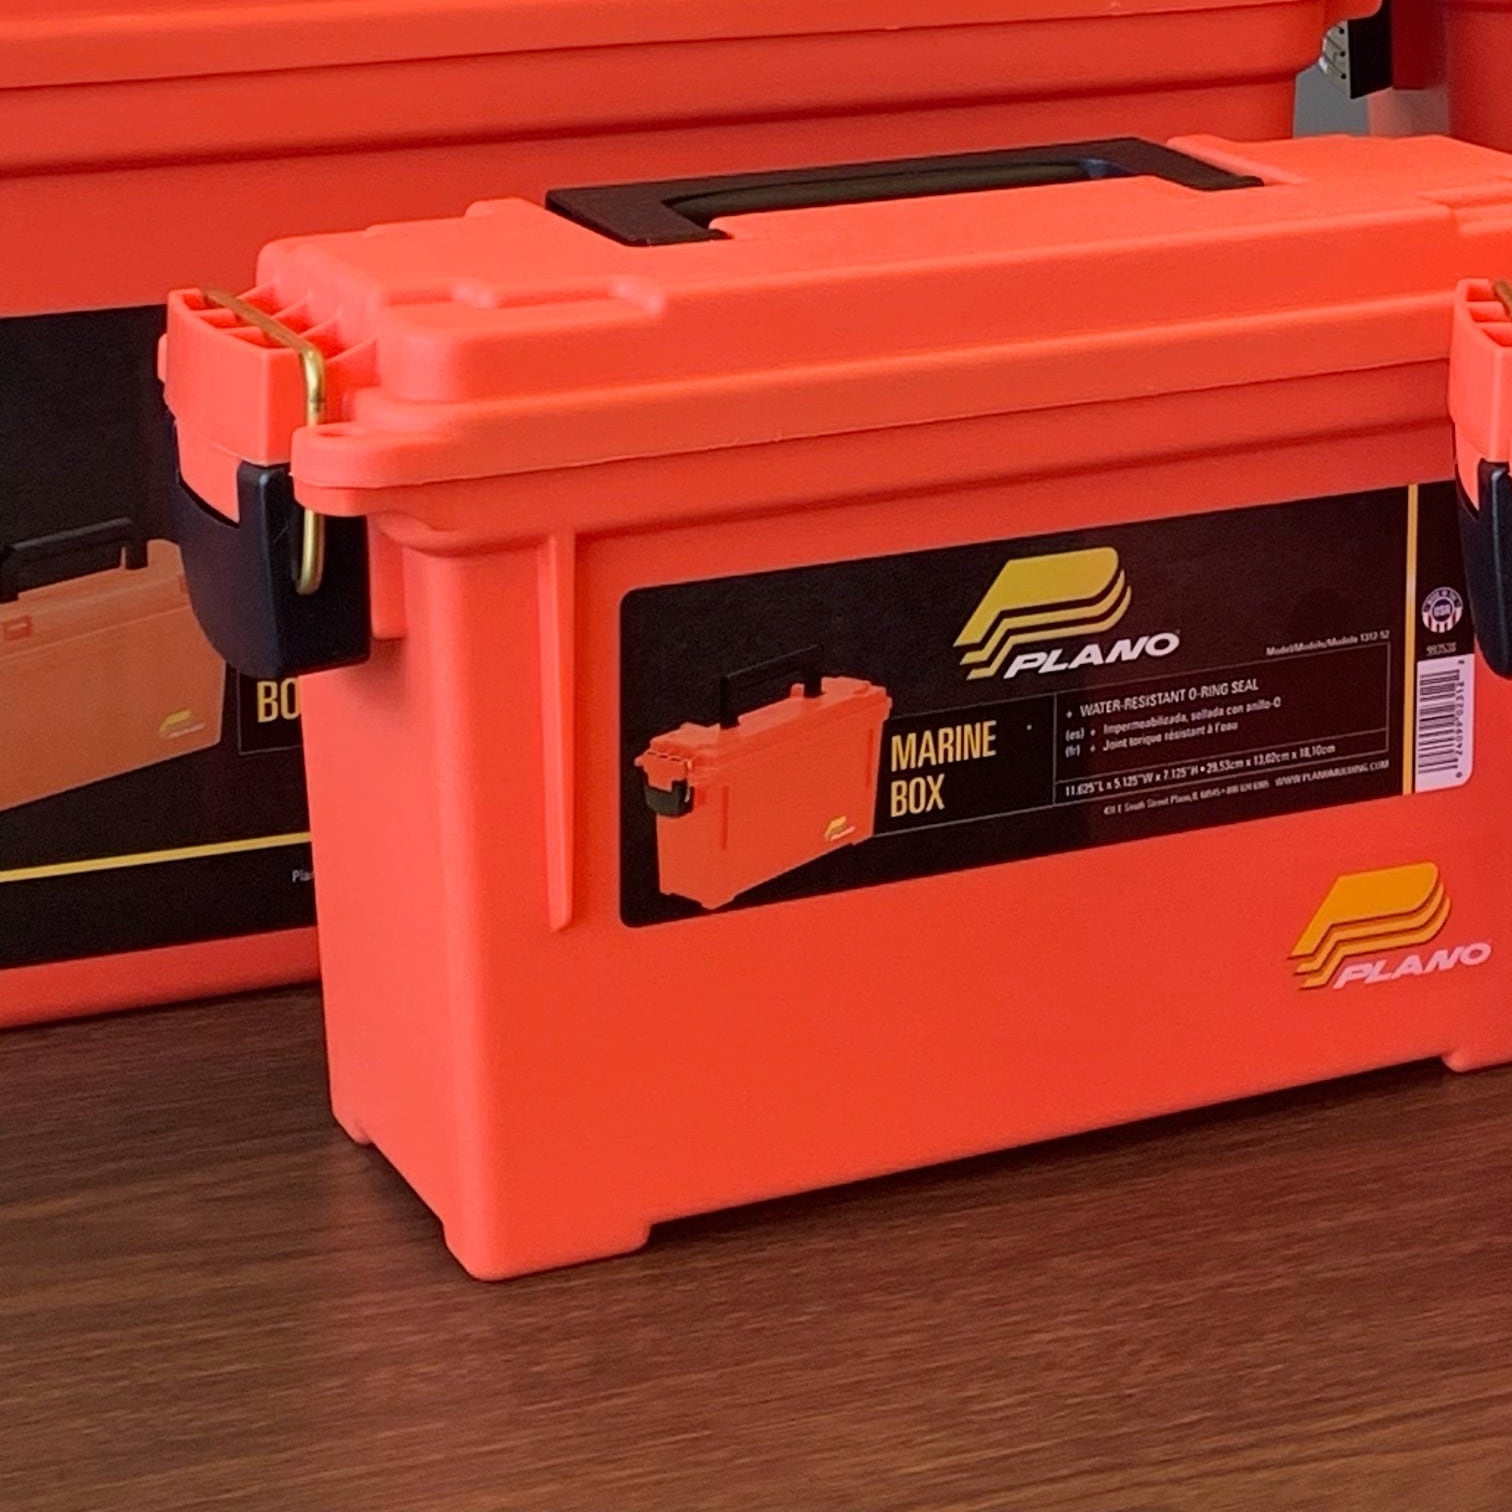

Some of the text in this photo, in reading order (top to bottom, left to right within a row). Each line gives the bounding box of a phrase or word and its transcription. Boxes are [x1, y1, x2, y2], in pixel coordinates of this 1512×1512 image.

[1003, 632, 1180, 679] PLANO
[257, 678, 300, 723] BO
[1080, 679, 1259, 716] WATER-RESISTANT O-RING SEAL
[891, 720, 998, 772] MARINE
[890, 773, 945, 818] BOX
[1333, 942, 1492, 989] PLANO
